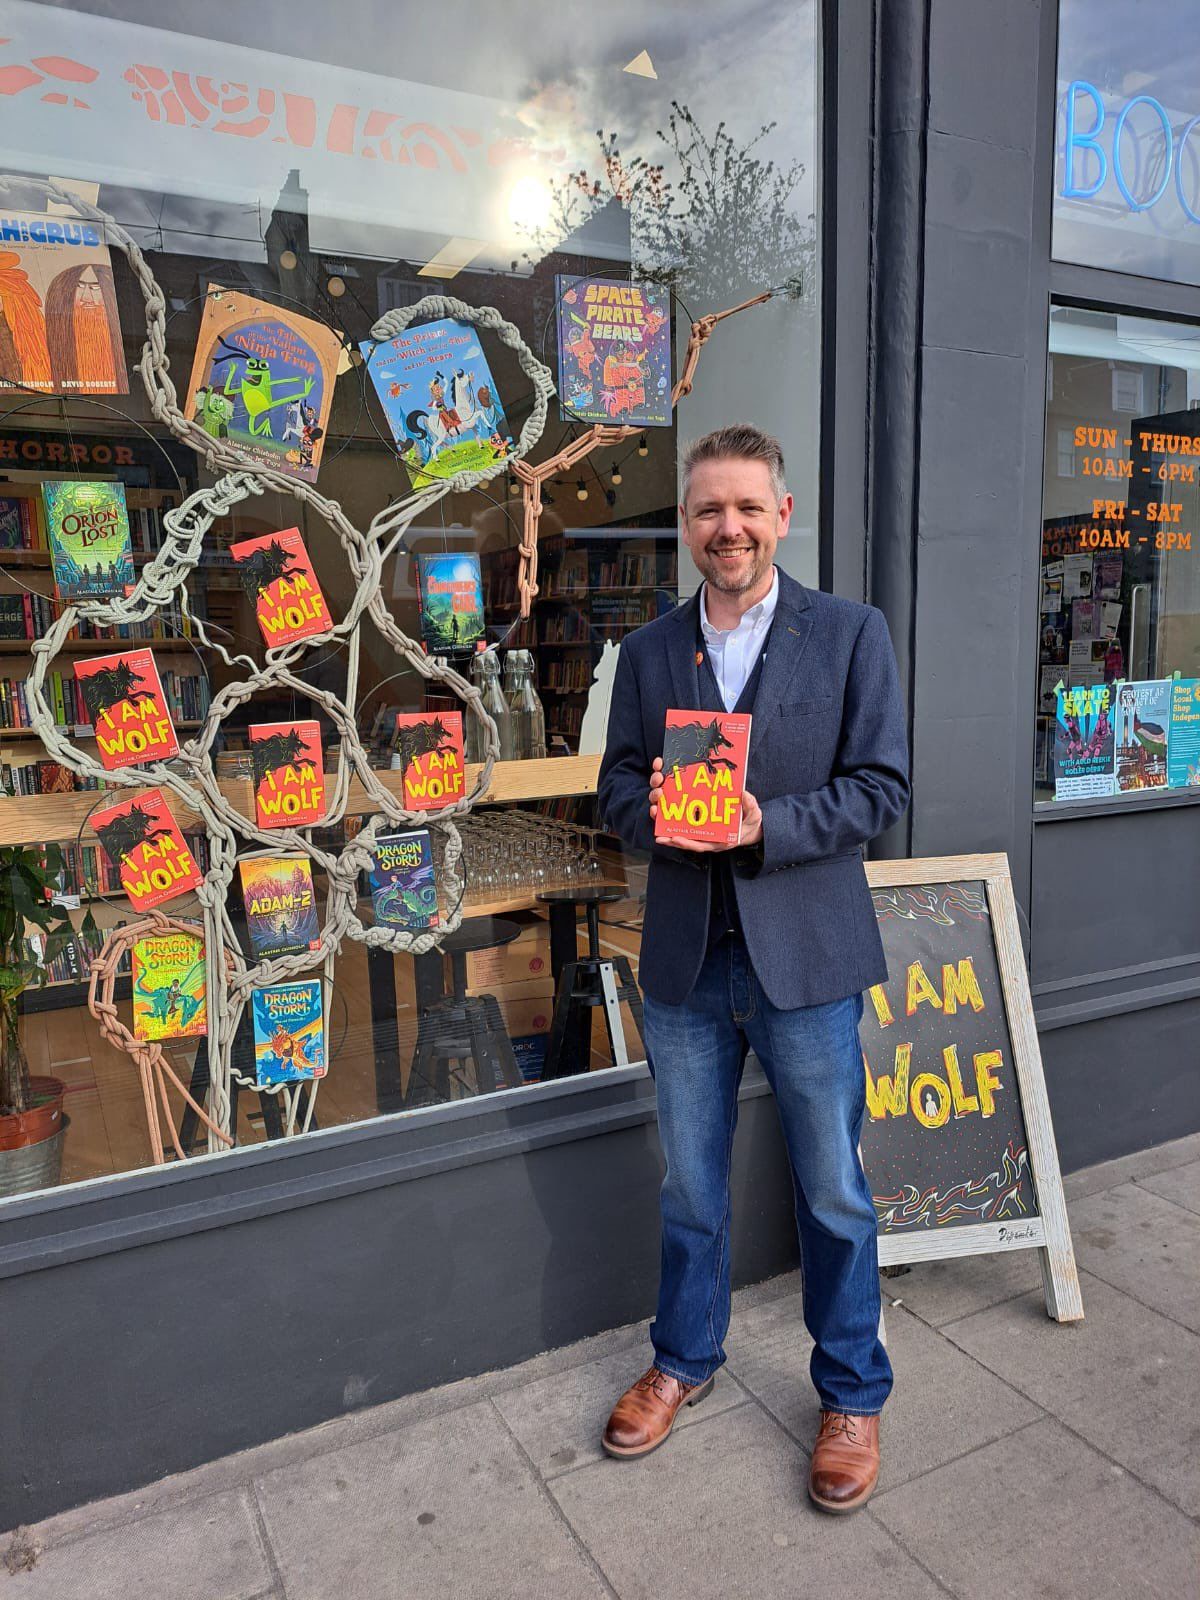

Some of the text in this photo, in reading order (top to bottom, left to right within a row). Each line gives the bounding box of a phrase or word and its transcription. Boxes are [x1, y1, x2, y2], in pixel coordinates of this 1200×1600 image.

[29, 221, 100, 247] GRUB
[584, 284, 644, 307] SPACE
[586, 304, 645, 325] PIRATE
[391, 339, 412, 349] The
[592, 323, 643, 342] BEARS
[233, 334, 315, 374] Ninja Frog
[397, 347, 426, 360] Witch
[426, 352, 453, 364] Bears
[61, 380, 85, 388] DAVID
[86, 380, 117, 388] ROBERTS
[0, 439, 136, 465] HORROR
[227, 440, 281, 460] Alastair Chisholm
[1074, 426, 1117, 449] SUN
[1139, 432, 1200, 456] THURS
[1081, 456, 1134, 478] 10AM
[1158, 462, 1194, 483] 6PM
[62, 506, 119, 535] ORION
[1092, 499, 1126, 520] FRI
[1146, 502, 1183, 522] SAT
[81, 523, 118, 547] LOST
[1079, 528, 1131, 548] 10AM
[1155, 531, 1191, 550] 8PM
[258, 574, 313, 607] I AM
[258, 594, 323, 633] WOLF
[1063, 688, 1110, 701] LEARN TO
[1121, 688, 1154, 700] PROTEST
[1174, 686, 1191, 695] Shop
[99, 698, 160, 729] I AM
[1063, 699, 1110, 717] SKATE
[1173, 704, 1190, 713] Shop
[96, 718, 169, 756] WOLF
[412, 751, 458, 775] I AM
[1059, 759, 1075, 767] WITH
[265, 764, 317, 791] I AM
[404, 771, 464, 799] WOLF
[672, 765, 734, 792] I AM
[257, 786, 323, 816] WOLF
[660, 793, 740, 827] WOLF
[120, 835, 179, 873] I AM
[374, 840, 423, 860] DRAGON
[381, 852, 422, 871] STORM
[121, 851, 192, 898] WOLF
[249, 889, 312, 916] ADAM-2
[144, 939, 196, 957] DRAGON
[149, 951, 196, 970] STORM
[263, 988, 313, 1009] DRAGON
[869, 956, 985, 1029] I AM
[268, 1003, 311, 1020] STORM
[862, 1041, 1005, 1129] WOLF
